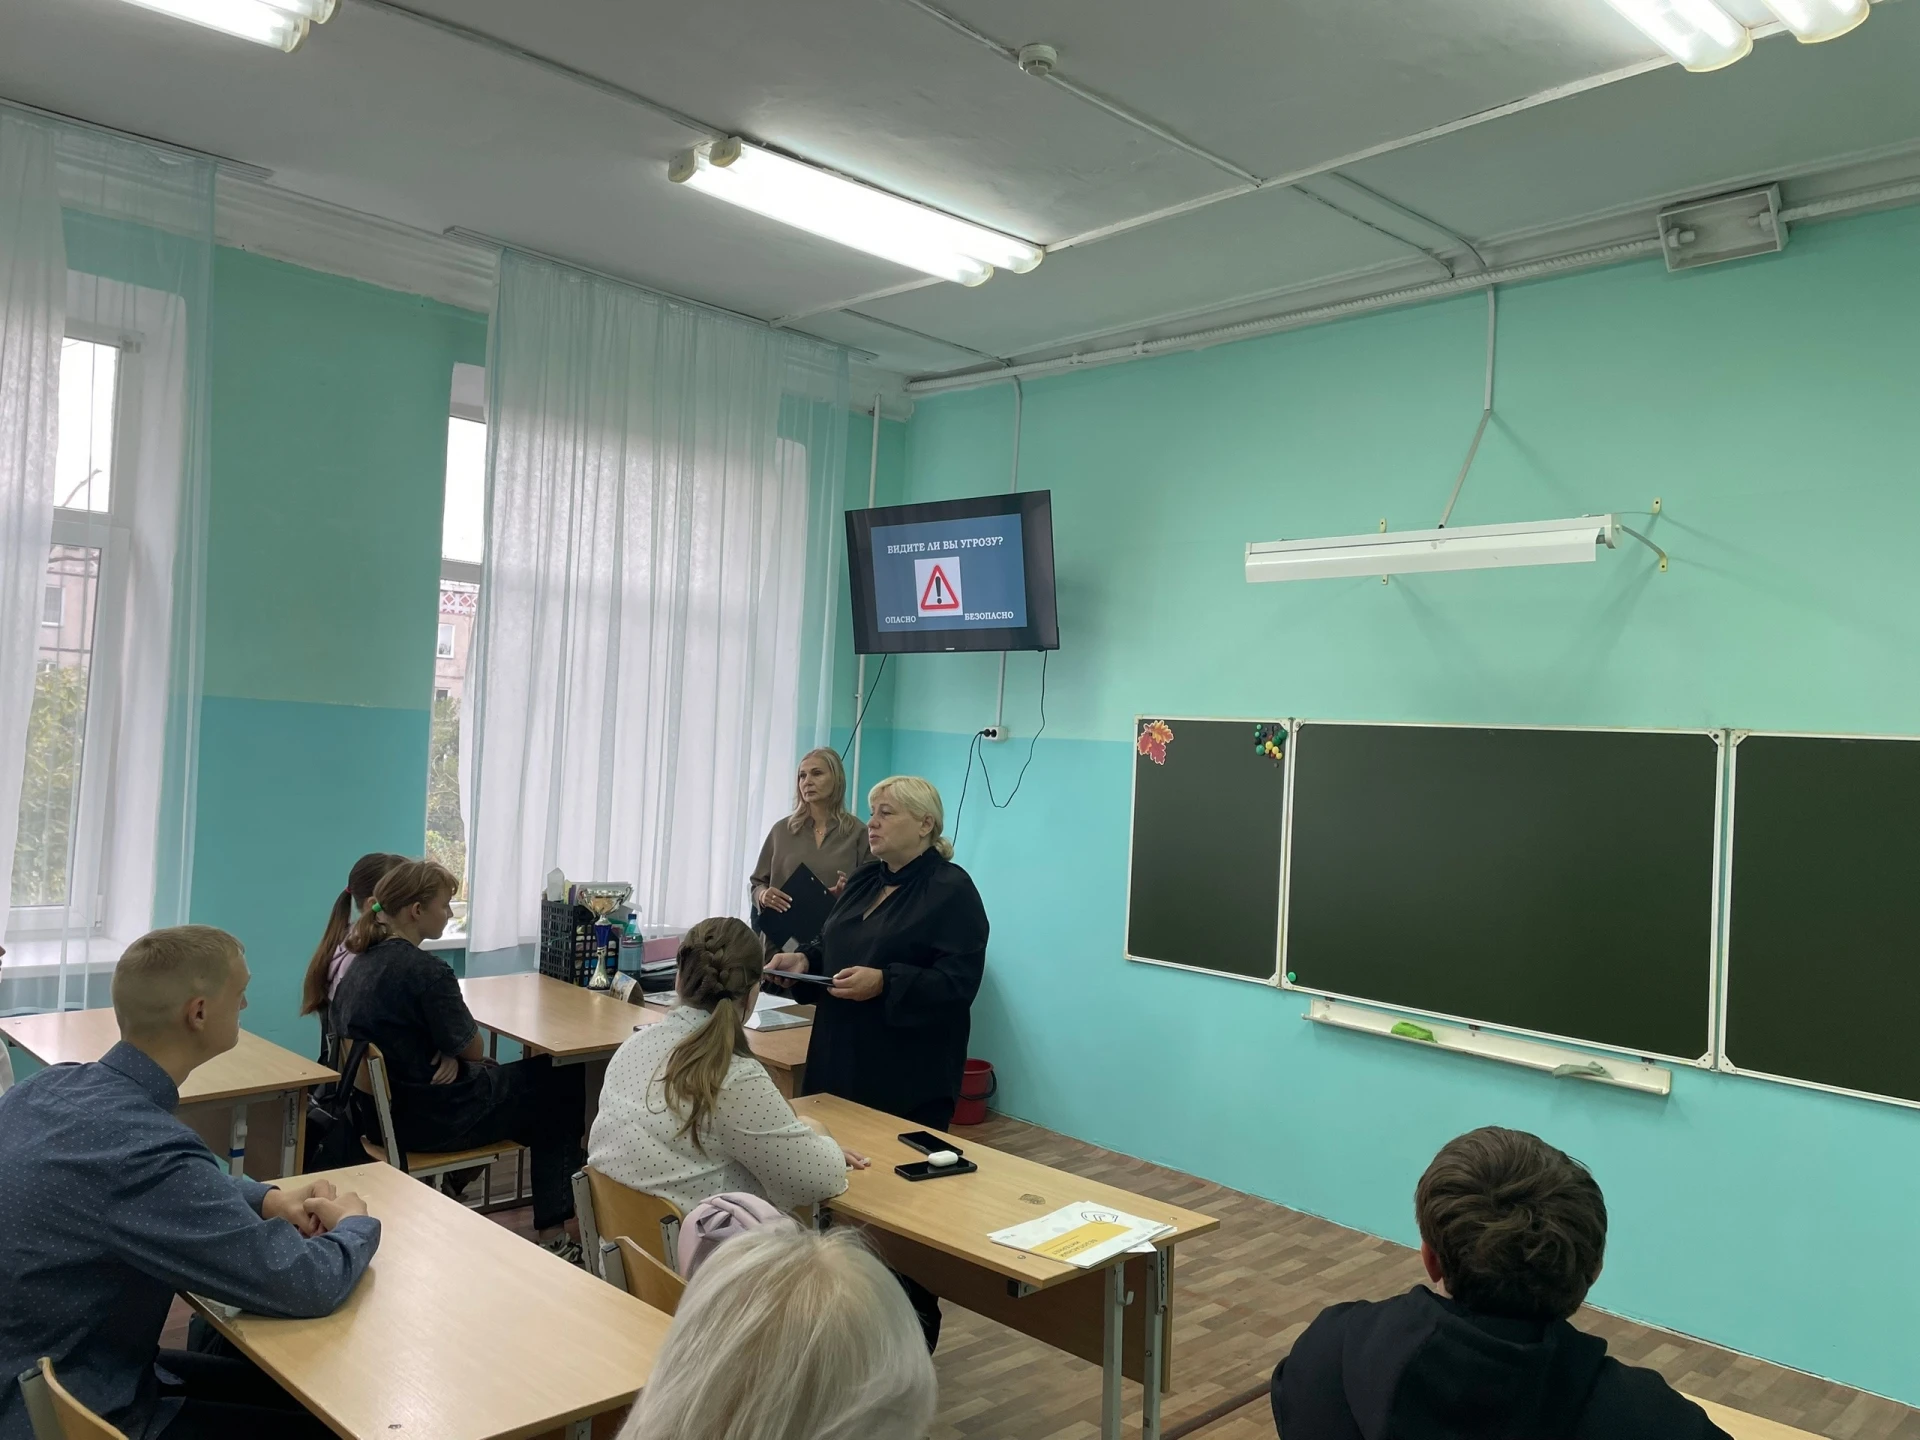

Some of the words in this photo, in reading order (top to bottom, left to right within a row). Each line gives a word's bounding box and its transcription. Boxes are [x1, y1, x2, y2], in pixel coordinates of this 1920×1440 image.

[887, 542, 925, 554] ВИДИТЕ
[927, 541, 941, 551] ЛИ
[943, 540, 958, 549] ВЫ
[960, 536, 1003, 549] УГРОЗУ?
[885, 615, 917, 624] ОПАСНО
[964, 611, 1014, 621] БЕЗОПАСНО
